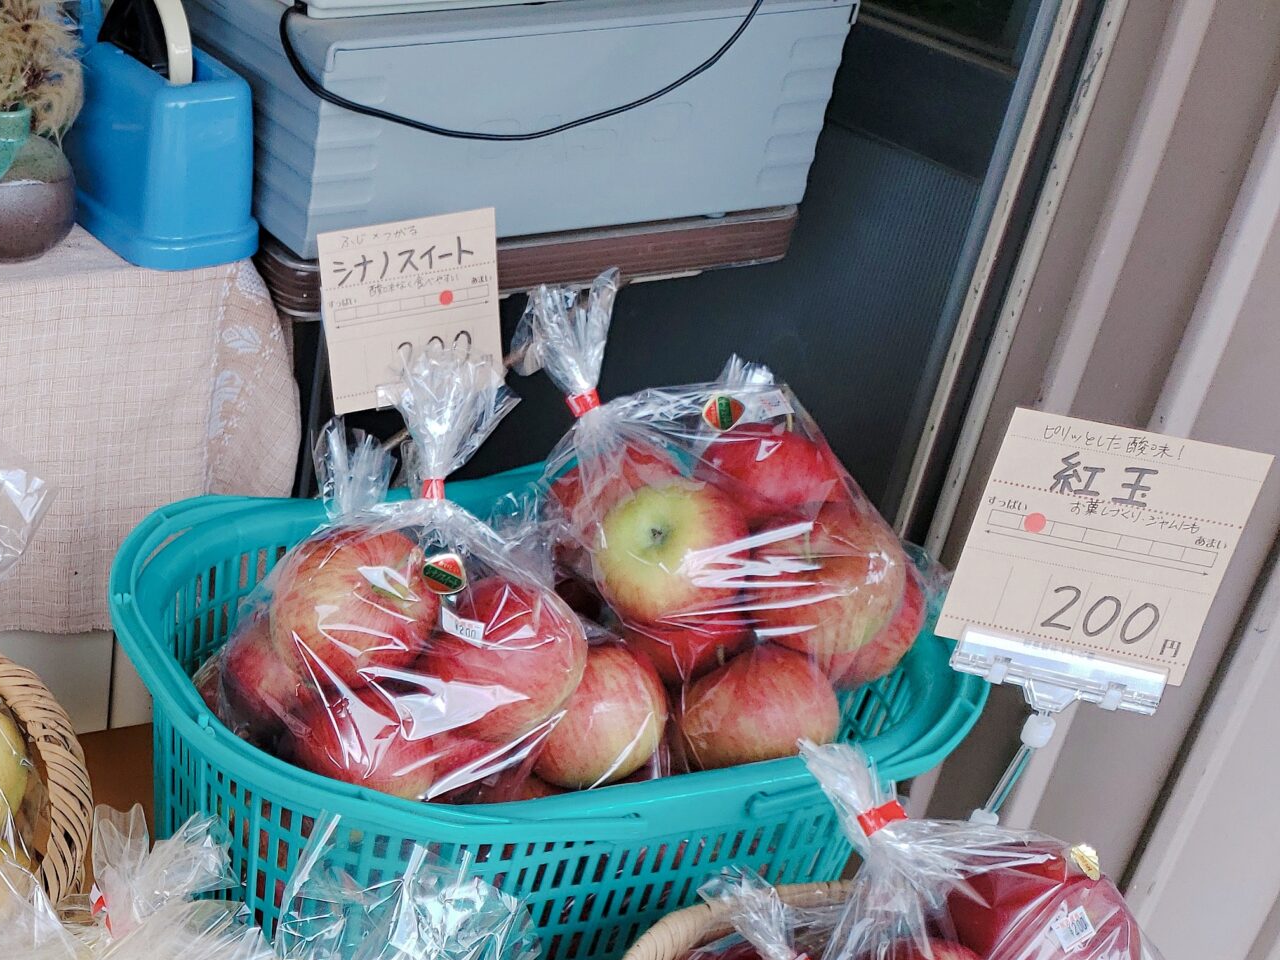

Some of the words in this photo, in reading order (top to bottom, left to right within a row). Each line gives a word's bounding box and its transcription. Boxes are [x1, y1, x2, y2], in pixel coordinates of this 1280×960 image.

[332, 235, 474, 287] シナノスイート
[1049, 450, 1160, 508] 紅玉
[1040, 585, 1160, 645] 200
[1159, 638, 1182, 658] 円
